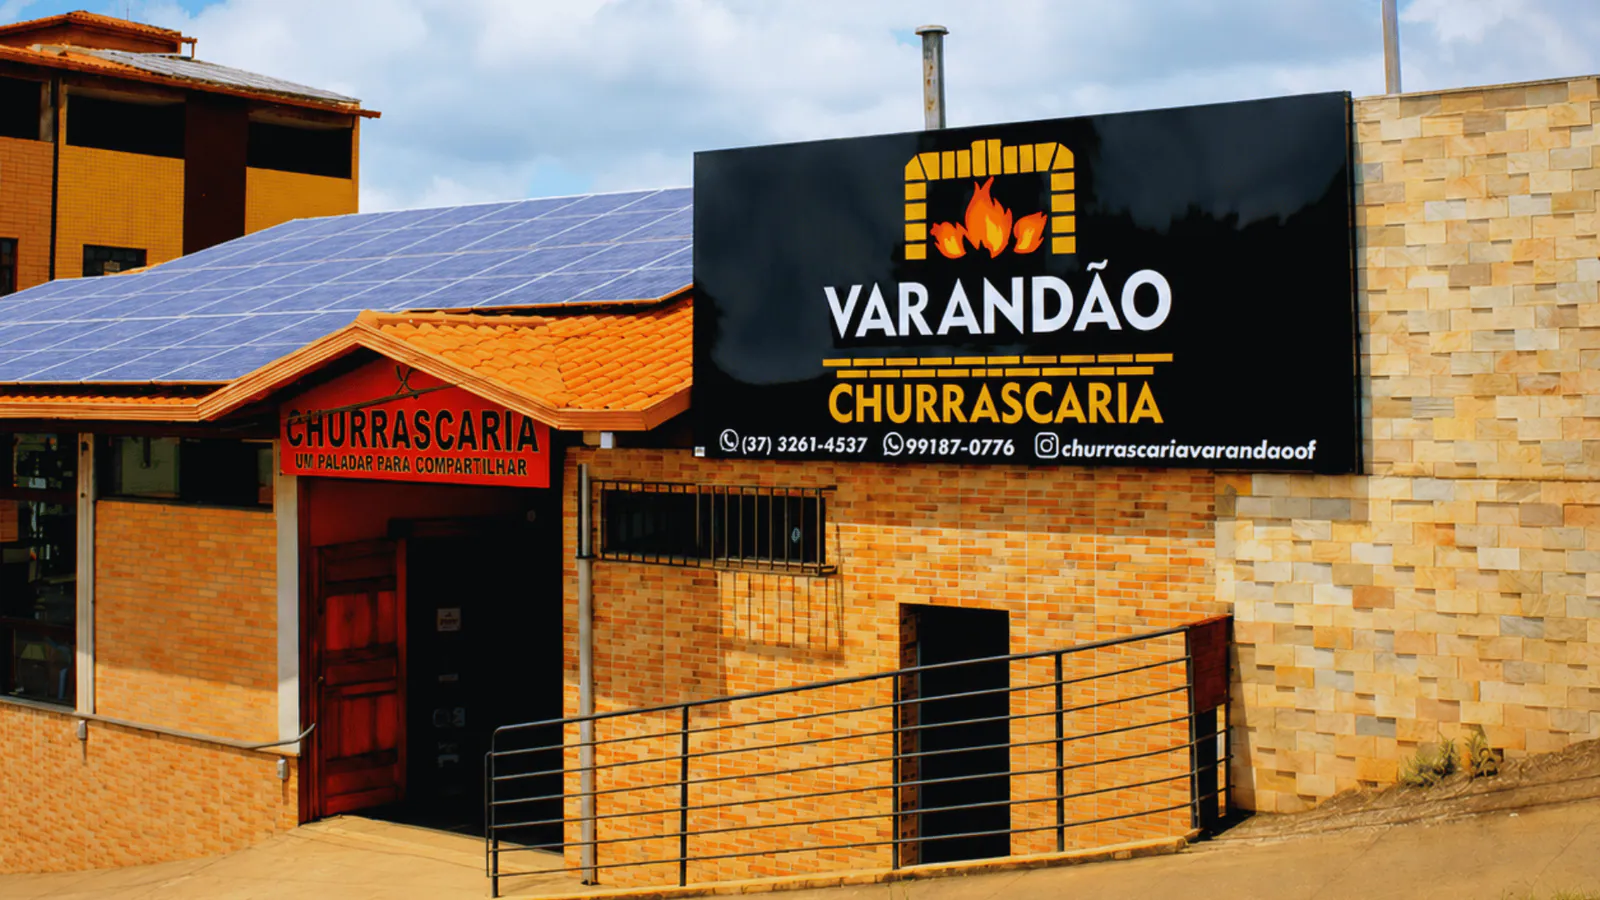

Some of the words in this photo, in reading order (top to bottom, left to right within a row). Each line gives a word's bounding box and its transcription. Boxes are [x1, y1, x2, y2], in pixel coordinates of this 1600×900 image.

[823, 259, 1173, 339] VARANDÃO
[828, 381, 1164, 425] CHURRASCARIA
[286, 409, 539, 452] CHURRASCARIA
[741, 436, 772, 456] (37)
[777, 436, 868, 453] 3261-4537
[906, 438, 1016, 456] 99187-0776
[1061, 438, 1317, 460] churrascariavarandaoof
[295, 454, 313, 469] UM
[317, 454, 373, 471] PALADAR
[377, 457, 411, 473] PARA
[415, 457, 528, 476] COMPARTILHAR
